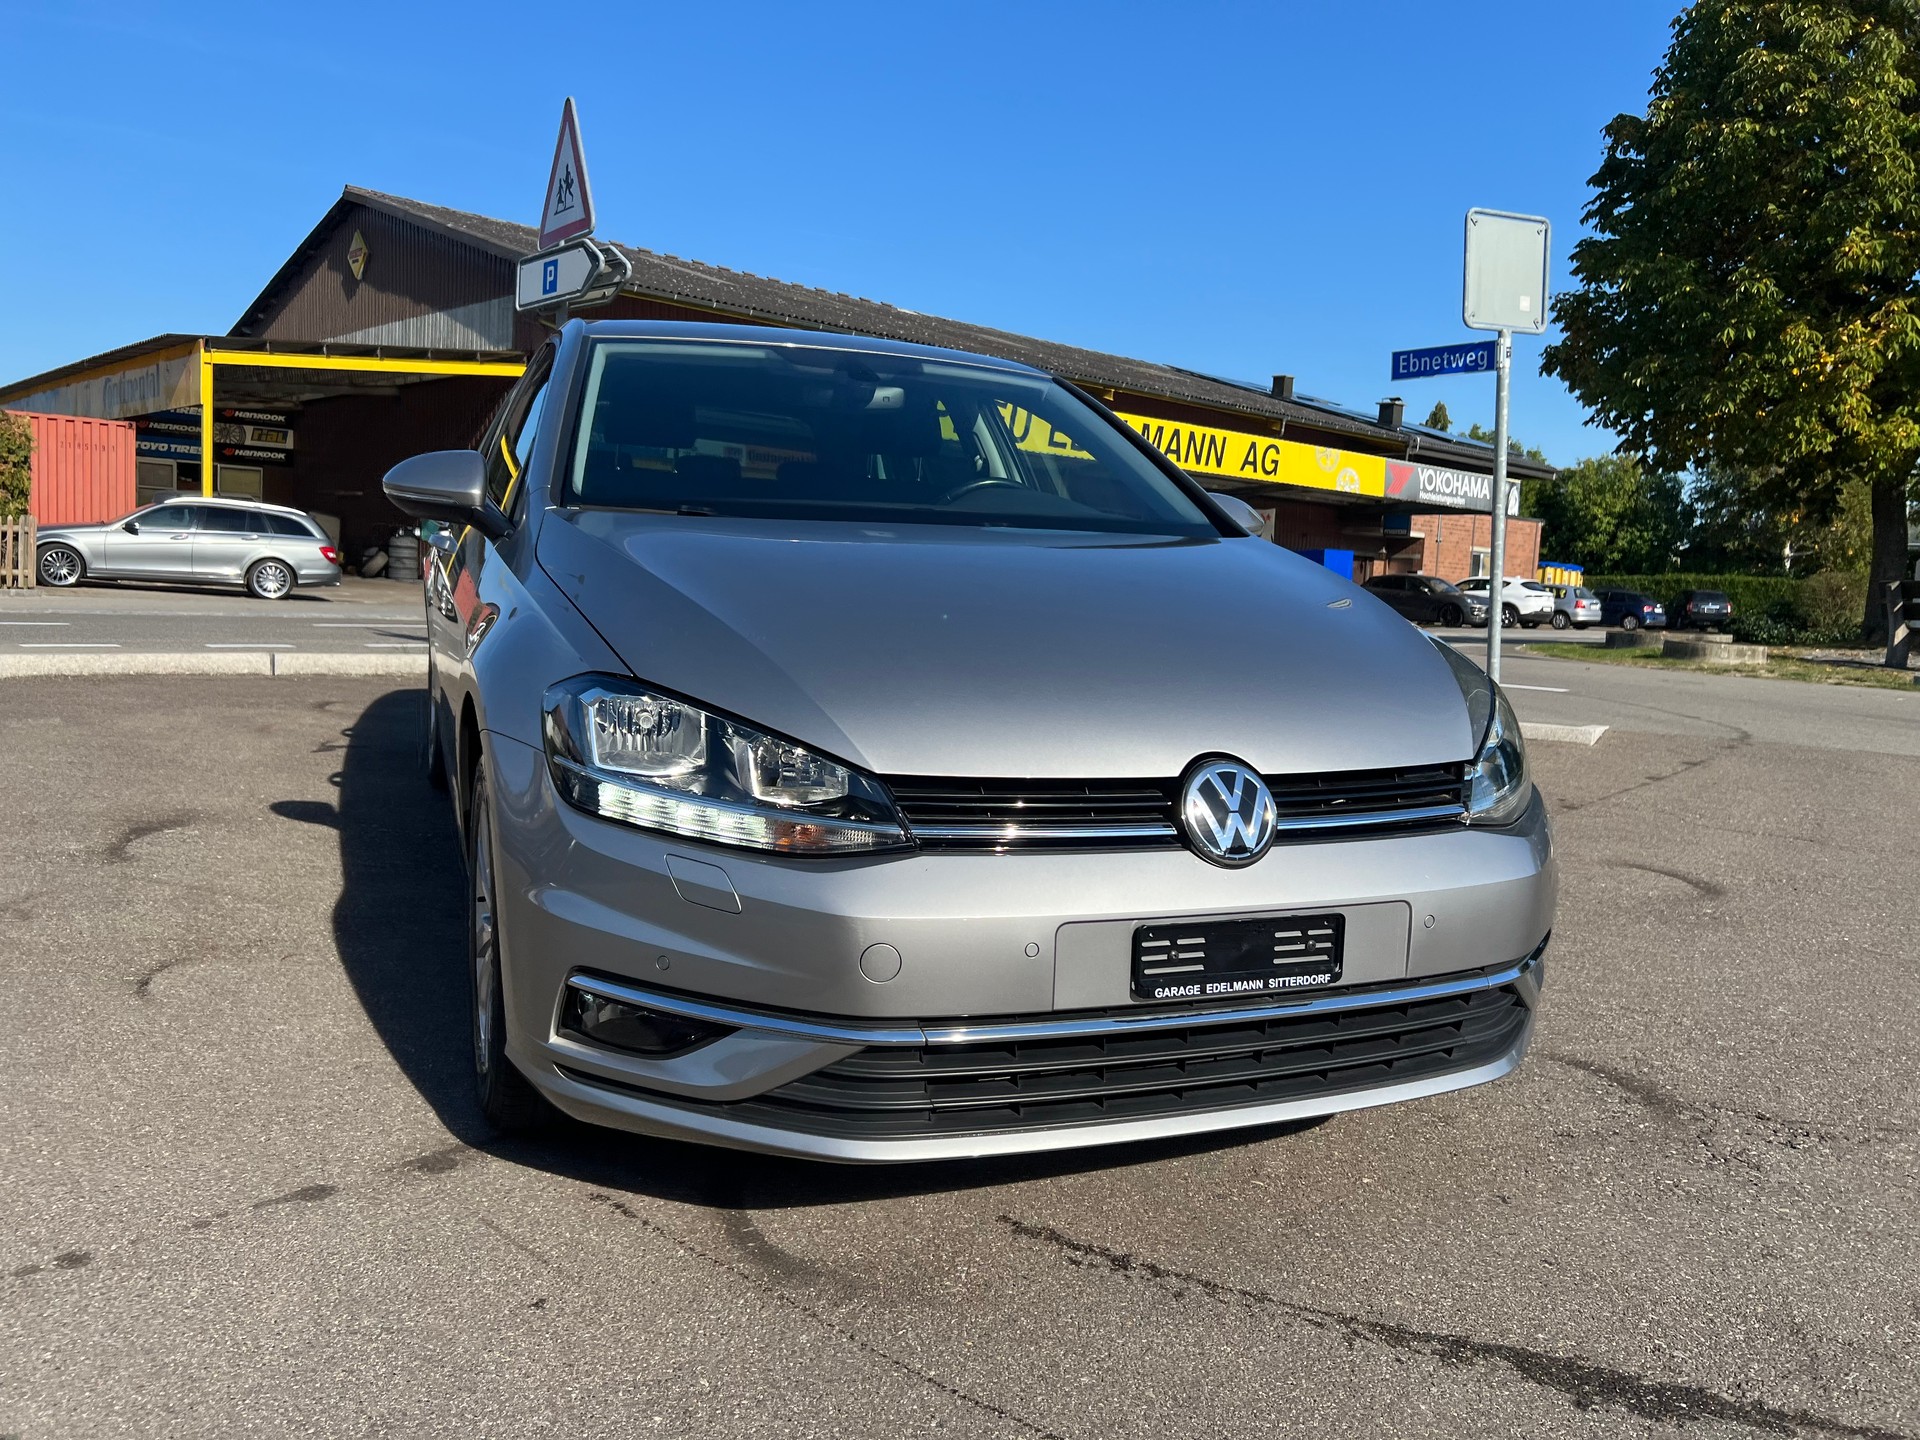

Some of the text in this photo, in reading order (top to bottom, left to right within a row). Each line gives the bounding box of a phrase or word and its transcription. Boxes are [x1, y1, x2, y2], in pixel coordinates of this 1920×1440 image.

[546, 265, 555, 290] P
[1399, 350, 1488, 373] Ebnetweg
[1122, 419, 1227, 469] MANN
[1239, 441, 1281, 476] AG
[1417, 467, 1490, 500] YOKOHAMA
[1155, 973, 1332, 998] GARAGE EDELMANN SITTERDORF
